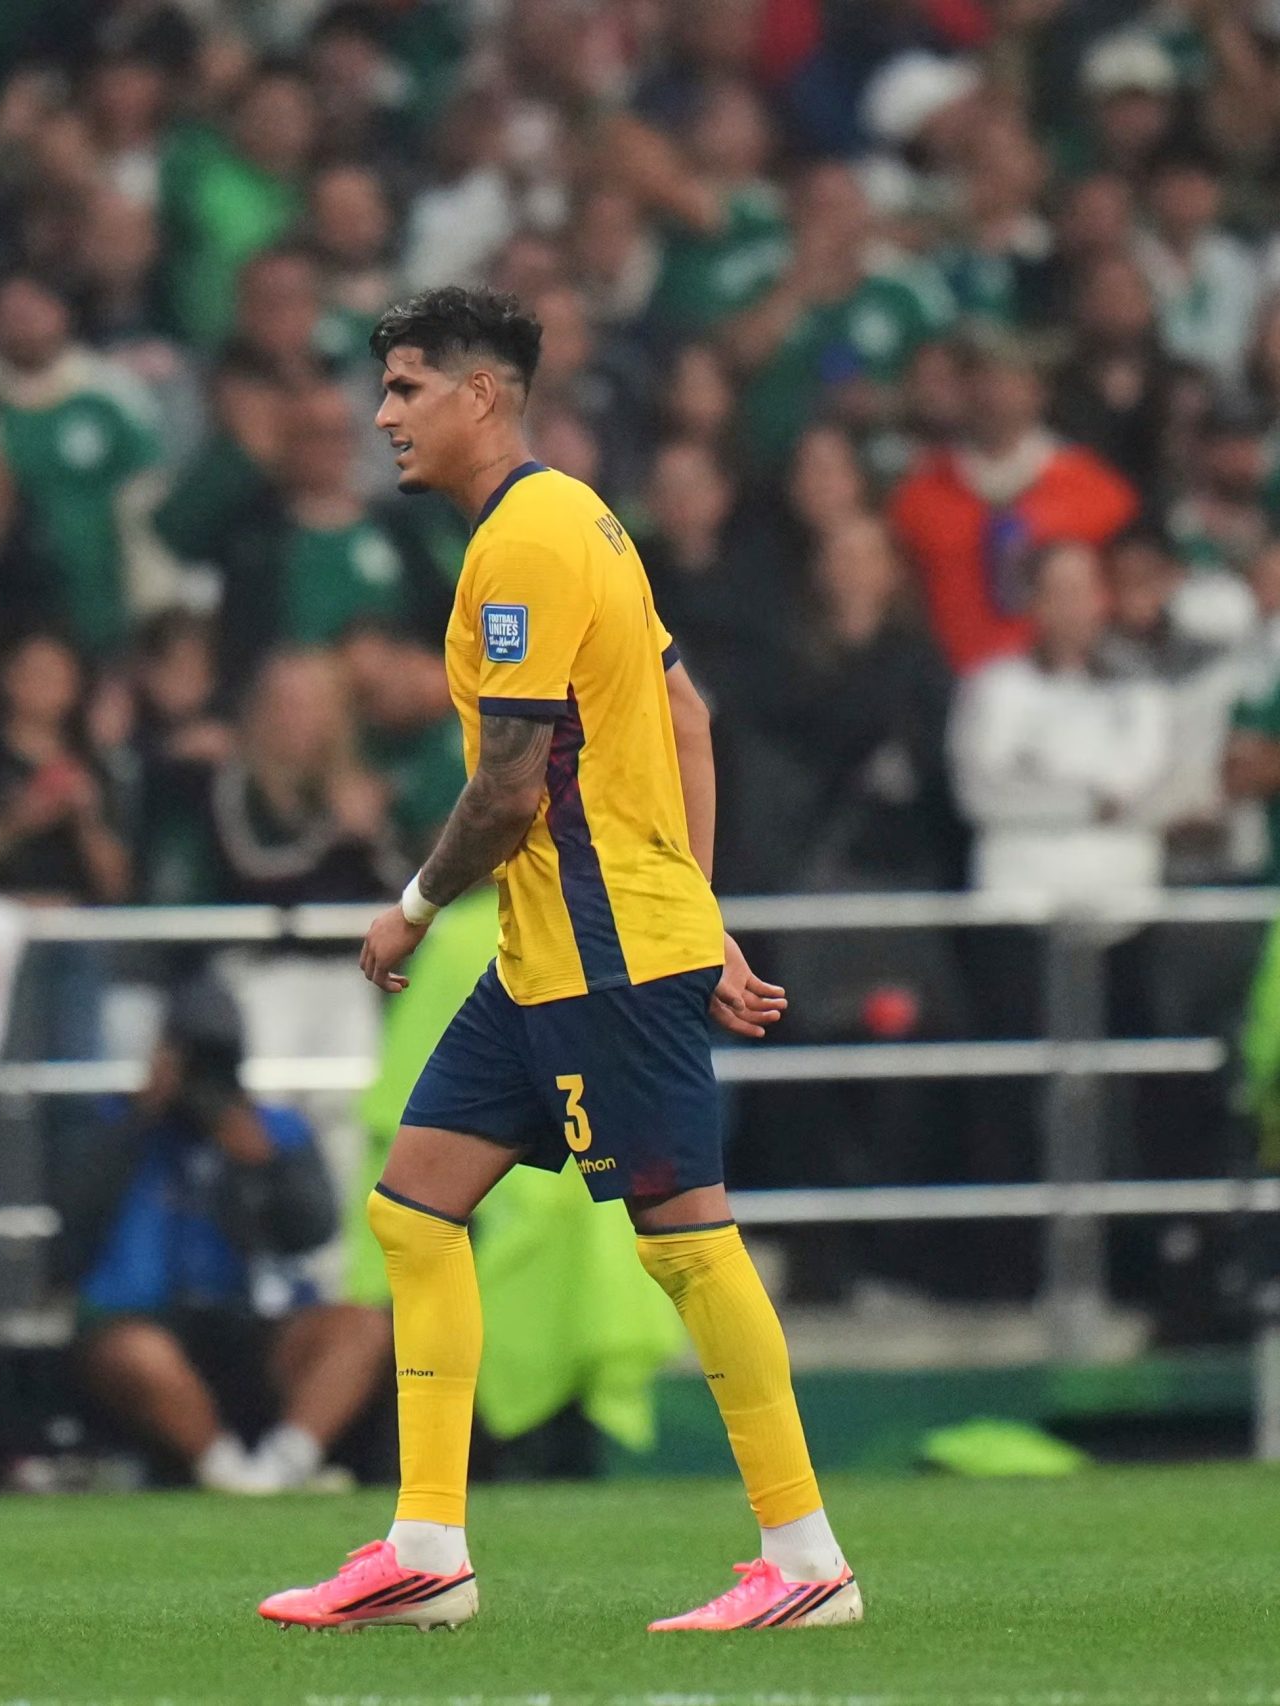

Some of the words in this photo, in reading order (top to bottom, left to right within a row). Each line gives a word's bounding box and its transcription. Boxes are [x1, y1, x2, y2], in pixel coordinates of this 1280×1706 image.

[488, 613, 519, 624] FOOTBALL
[488, 623, 519, 636] UNITES
[555, 1073, 592, 1153] 3
